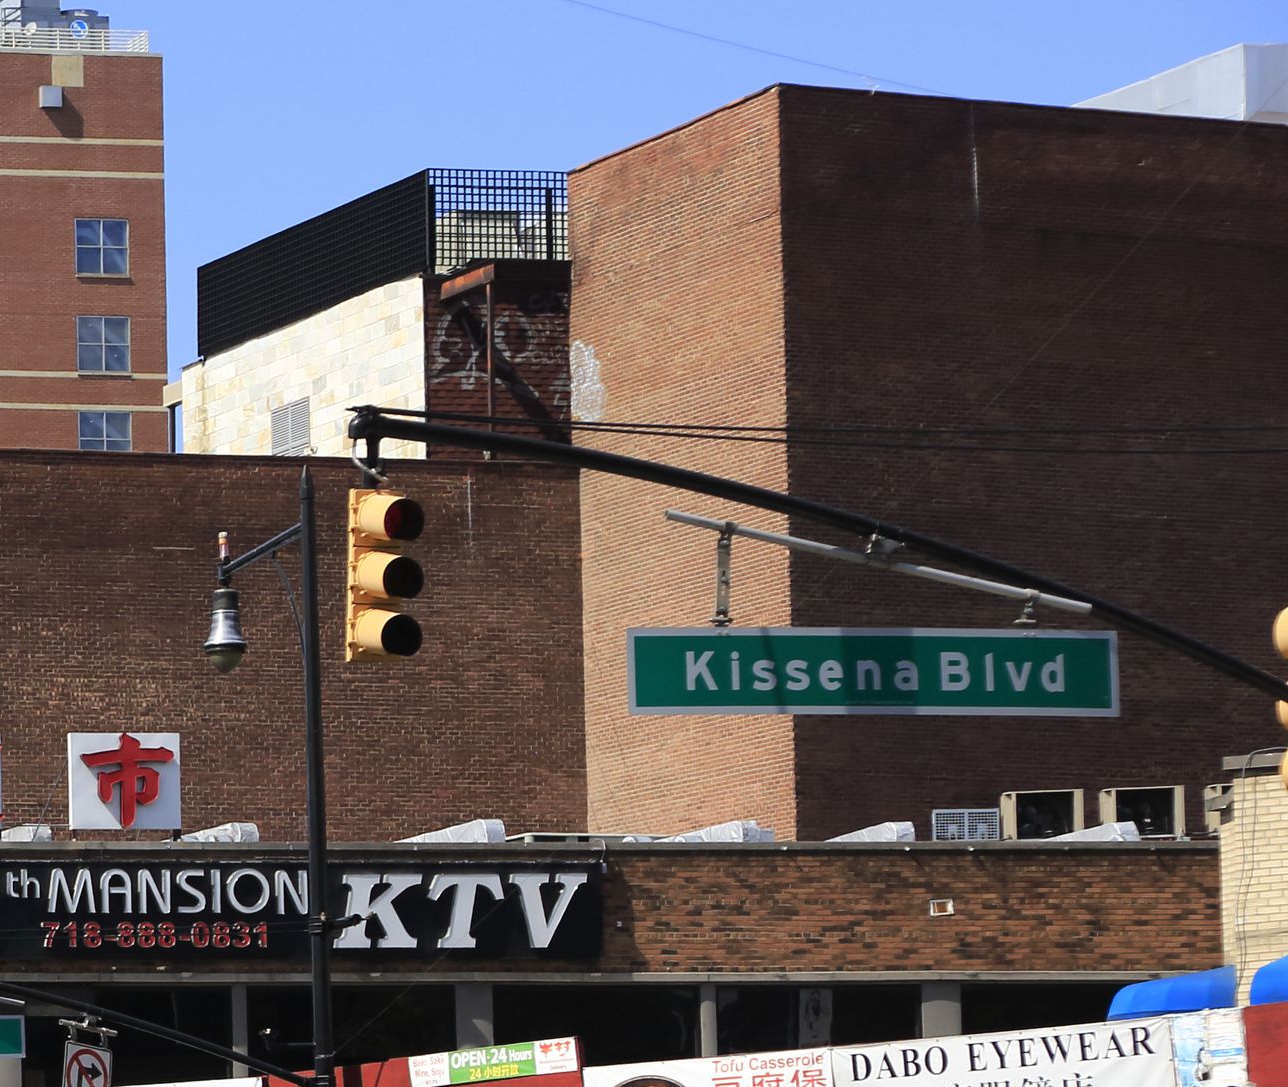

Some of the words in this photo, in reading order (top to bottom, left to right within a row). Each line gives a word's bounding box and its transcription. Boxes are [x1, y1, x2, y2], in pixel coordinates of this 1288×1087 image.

[684, 650, 919, 692] Kissena
[939, 651, 1067, 692] Blvd
[48, 867, 309, 916] MANSION
[332, 872, 589, 950] KTV
[40, 921, 270, 950] 718-888-0831
[509, 1049, 533, 1061] Hours
[712, 1060, 744, 1074] Tofu
[748, 1052, 824, 1071] Casserole
[850, 1045, 949, 1082] DABO
[967, 1026, 1157, 1073] EYEWEAR
